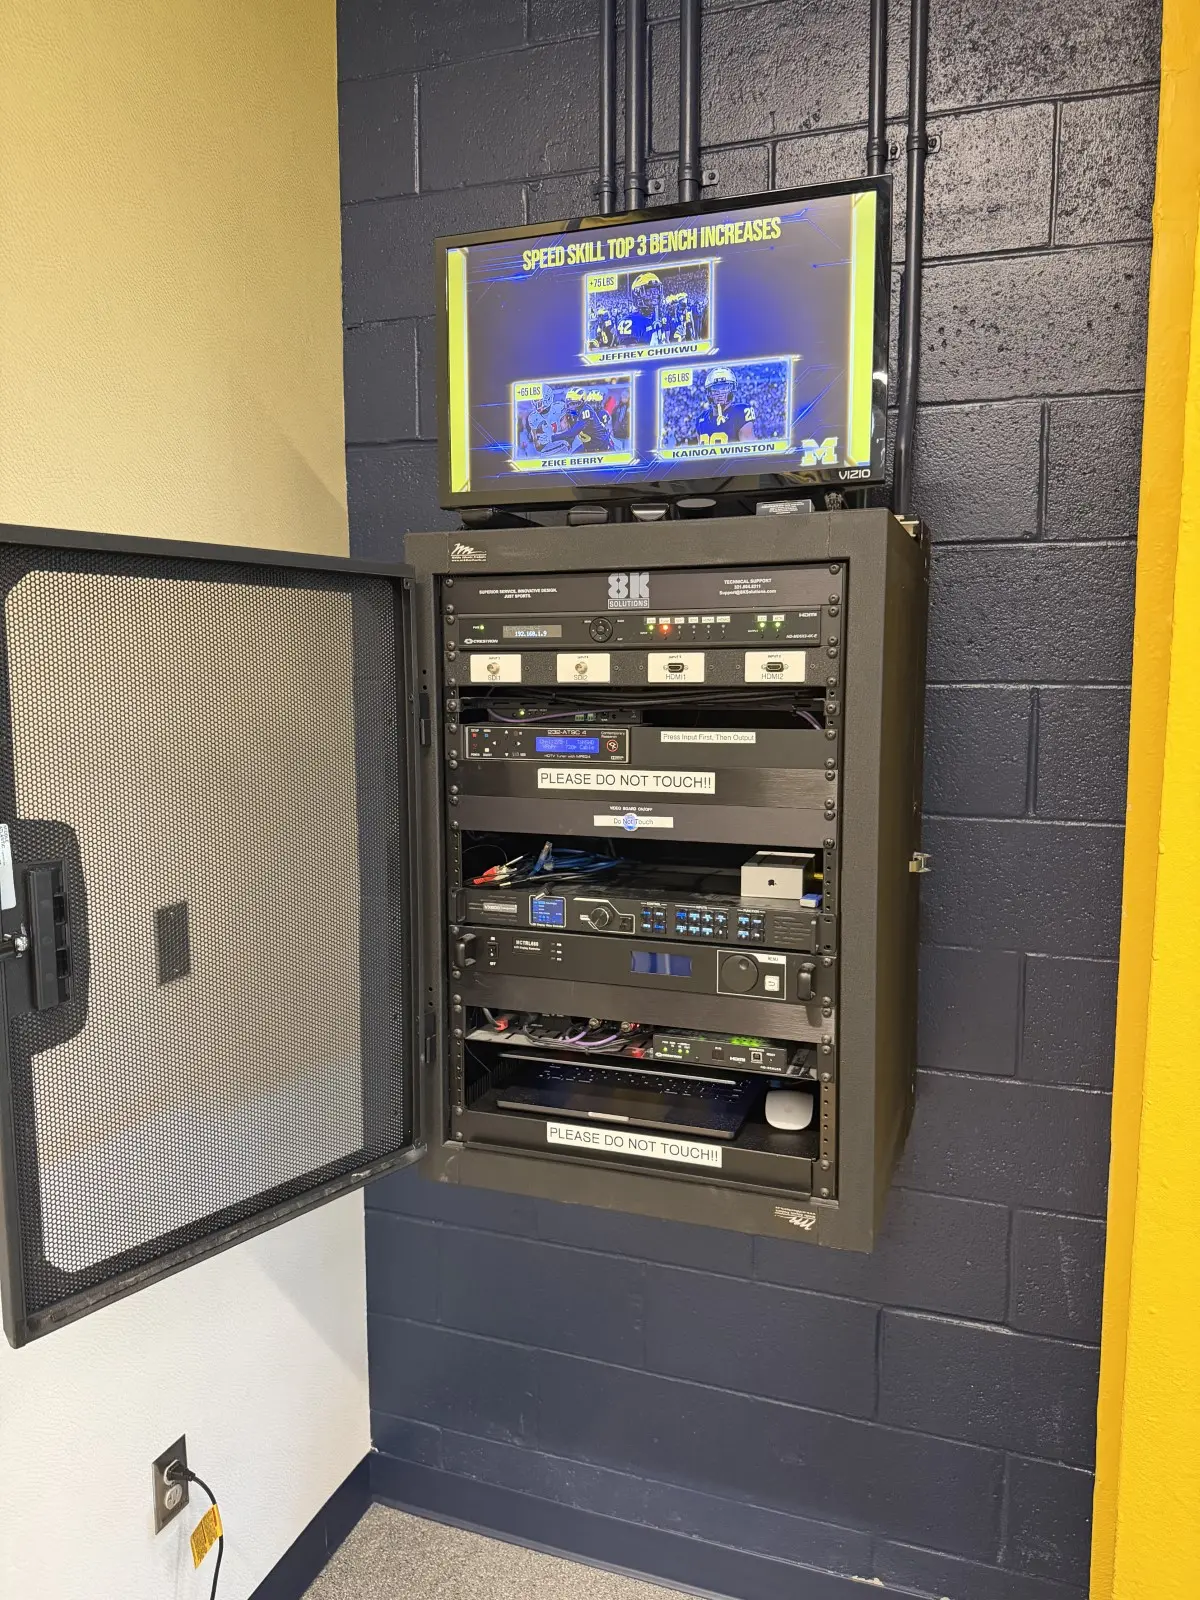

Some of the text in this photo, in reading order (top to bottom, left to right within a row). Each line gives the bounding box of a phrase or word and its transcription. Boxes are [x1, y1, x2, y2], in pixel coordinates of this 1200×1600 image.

[522, 217, 781, 271] SPEED SKILL TOP 3 BENCH INCREASES
[590, 277, 615, 288] +75 LBS
[617, 319, 633, 335] 42
[599, 345, 698, 361] JEFFREY CHUKWU
[664, 373, 690, 383] +65 LBS
[529, 386, 541, 395] LBS
[672, 444, 775, 458] KAINOA WINSTON
[541, 457, 604, 467] ZEKE BERRY
[838, 469, 871, 480] VIZIO
[608, 572, 649, 598] 8K
[609, 600, 648, 608] SOLUTIONS
[540, 772, 712, 789] PLEASE DO NOT TOUCH!!
[550, 1127, 718, 1162] PLEASE DO NOT TOUCH!!
